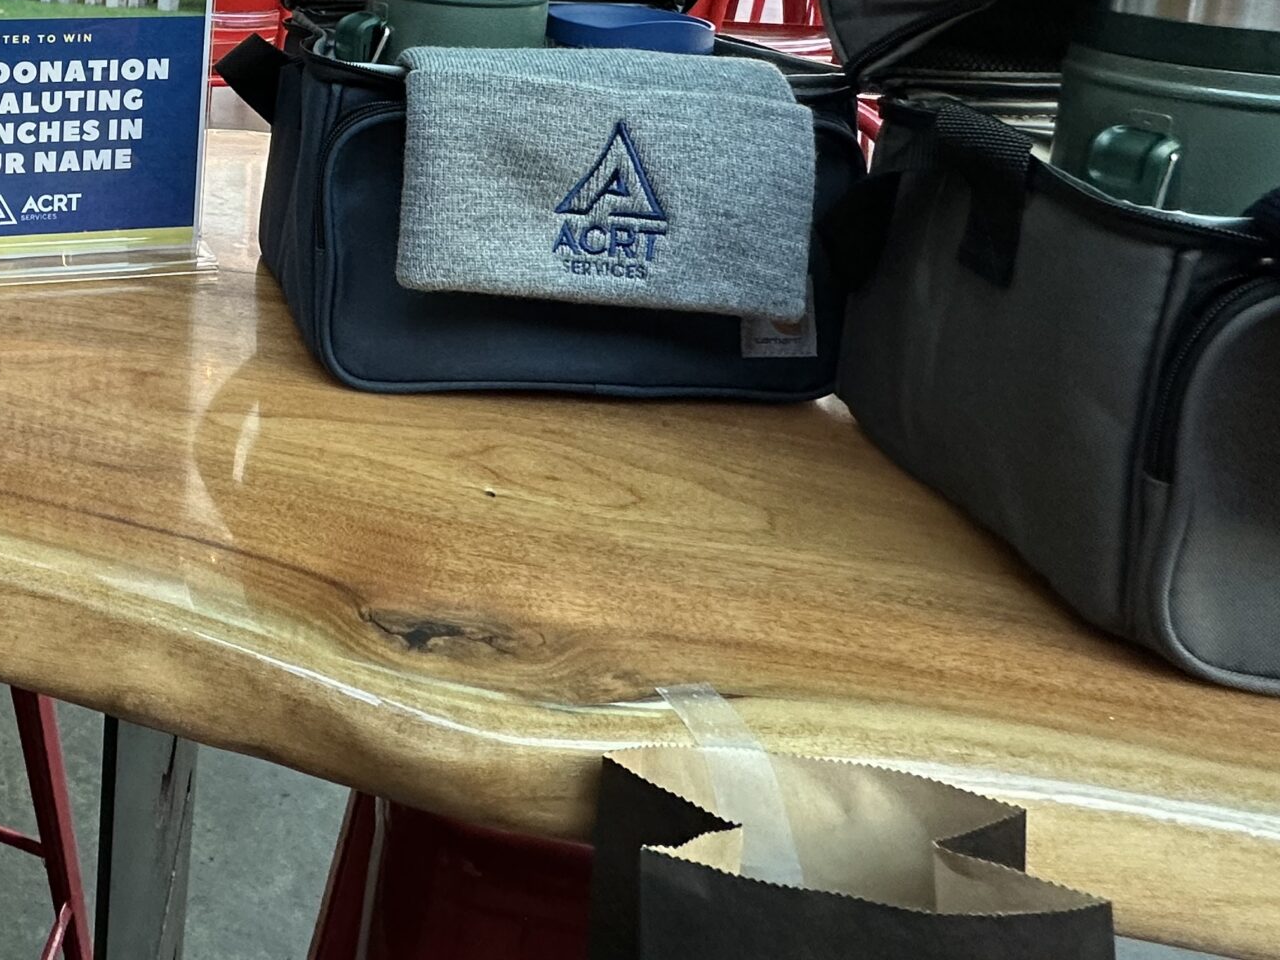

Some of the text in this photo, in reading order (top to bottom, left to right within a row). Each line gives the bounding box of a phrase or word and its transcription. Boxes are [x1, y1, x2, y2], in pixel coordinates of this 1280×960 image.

[37, 35, 55, 43] TO
[63, 33, 92, 43] WIN
[108, 118, 143, 141] IN
[34, 148, 132, 173] NAME
[21, 193, 82, 214] ACRT
[20, 213, 57, 221] SERVICES
[552, 220, 667, 261] ACRT
[562, 259, 648, 279] SERVICES
